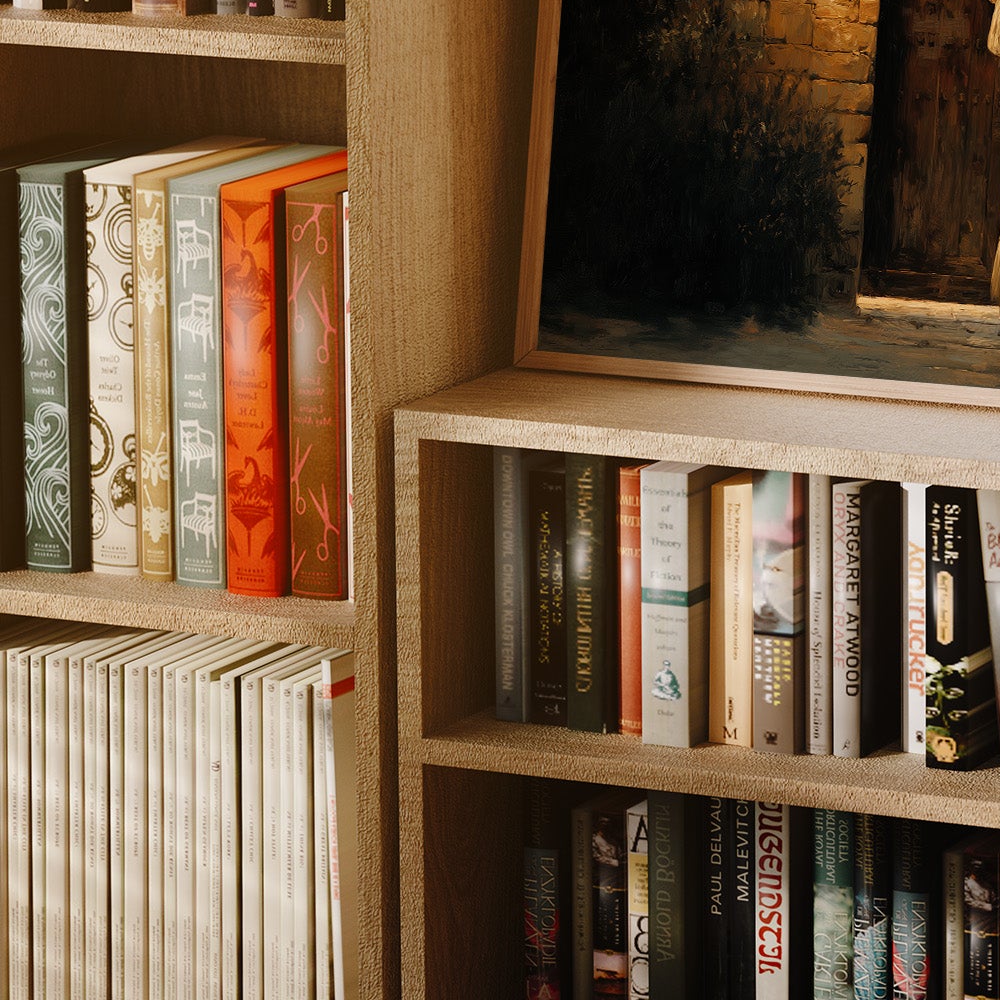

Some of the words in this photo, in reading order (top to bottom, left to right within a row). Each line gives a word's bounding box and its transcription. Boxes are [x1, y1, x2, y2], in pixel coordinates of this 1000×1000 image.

[502, 455, 513, 527] DOWNTOWN
[661, 504, 672, 514] of
[834, 492, 846, 544] ORYX
[503, 531, 514, 557] OWL
[650, 537, 682, 551] Theory
[846, 493, 860, 606] MARGARET
[503, 563, 514, 607] CHUCK
[834, 550, 846, 597] AND
[502, 610, 514, 691] KLOSTERMAN
[834, 601, 846, 670] CRAKE
[846, 611, 860, 697] ATWOOD
[722, 726, 738, 740] M
[711, 872, 722, 915] PAUL
